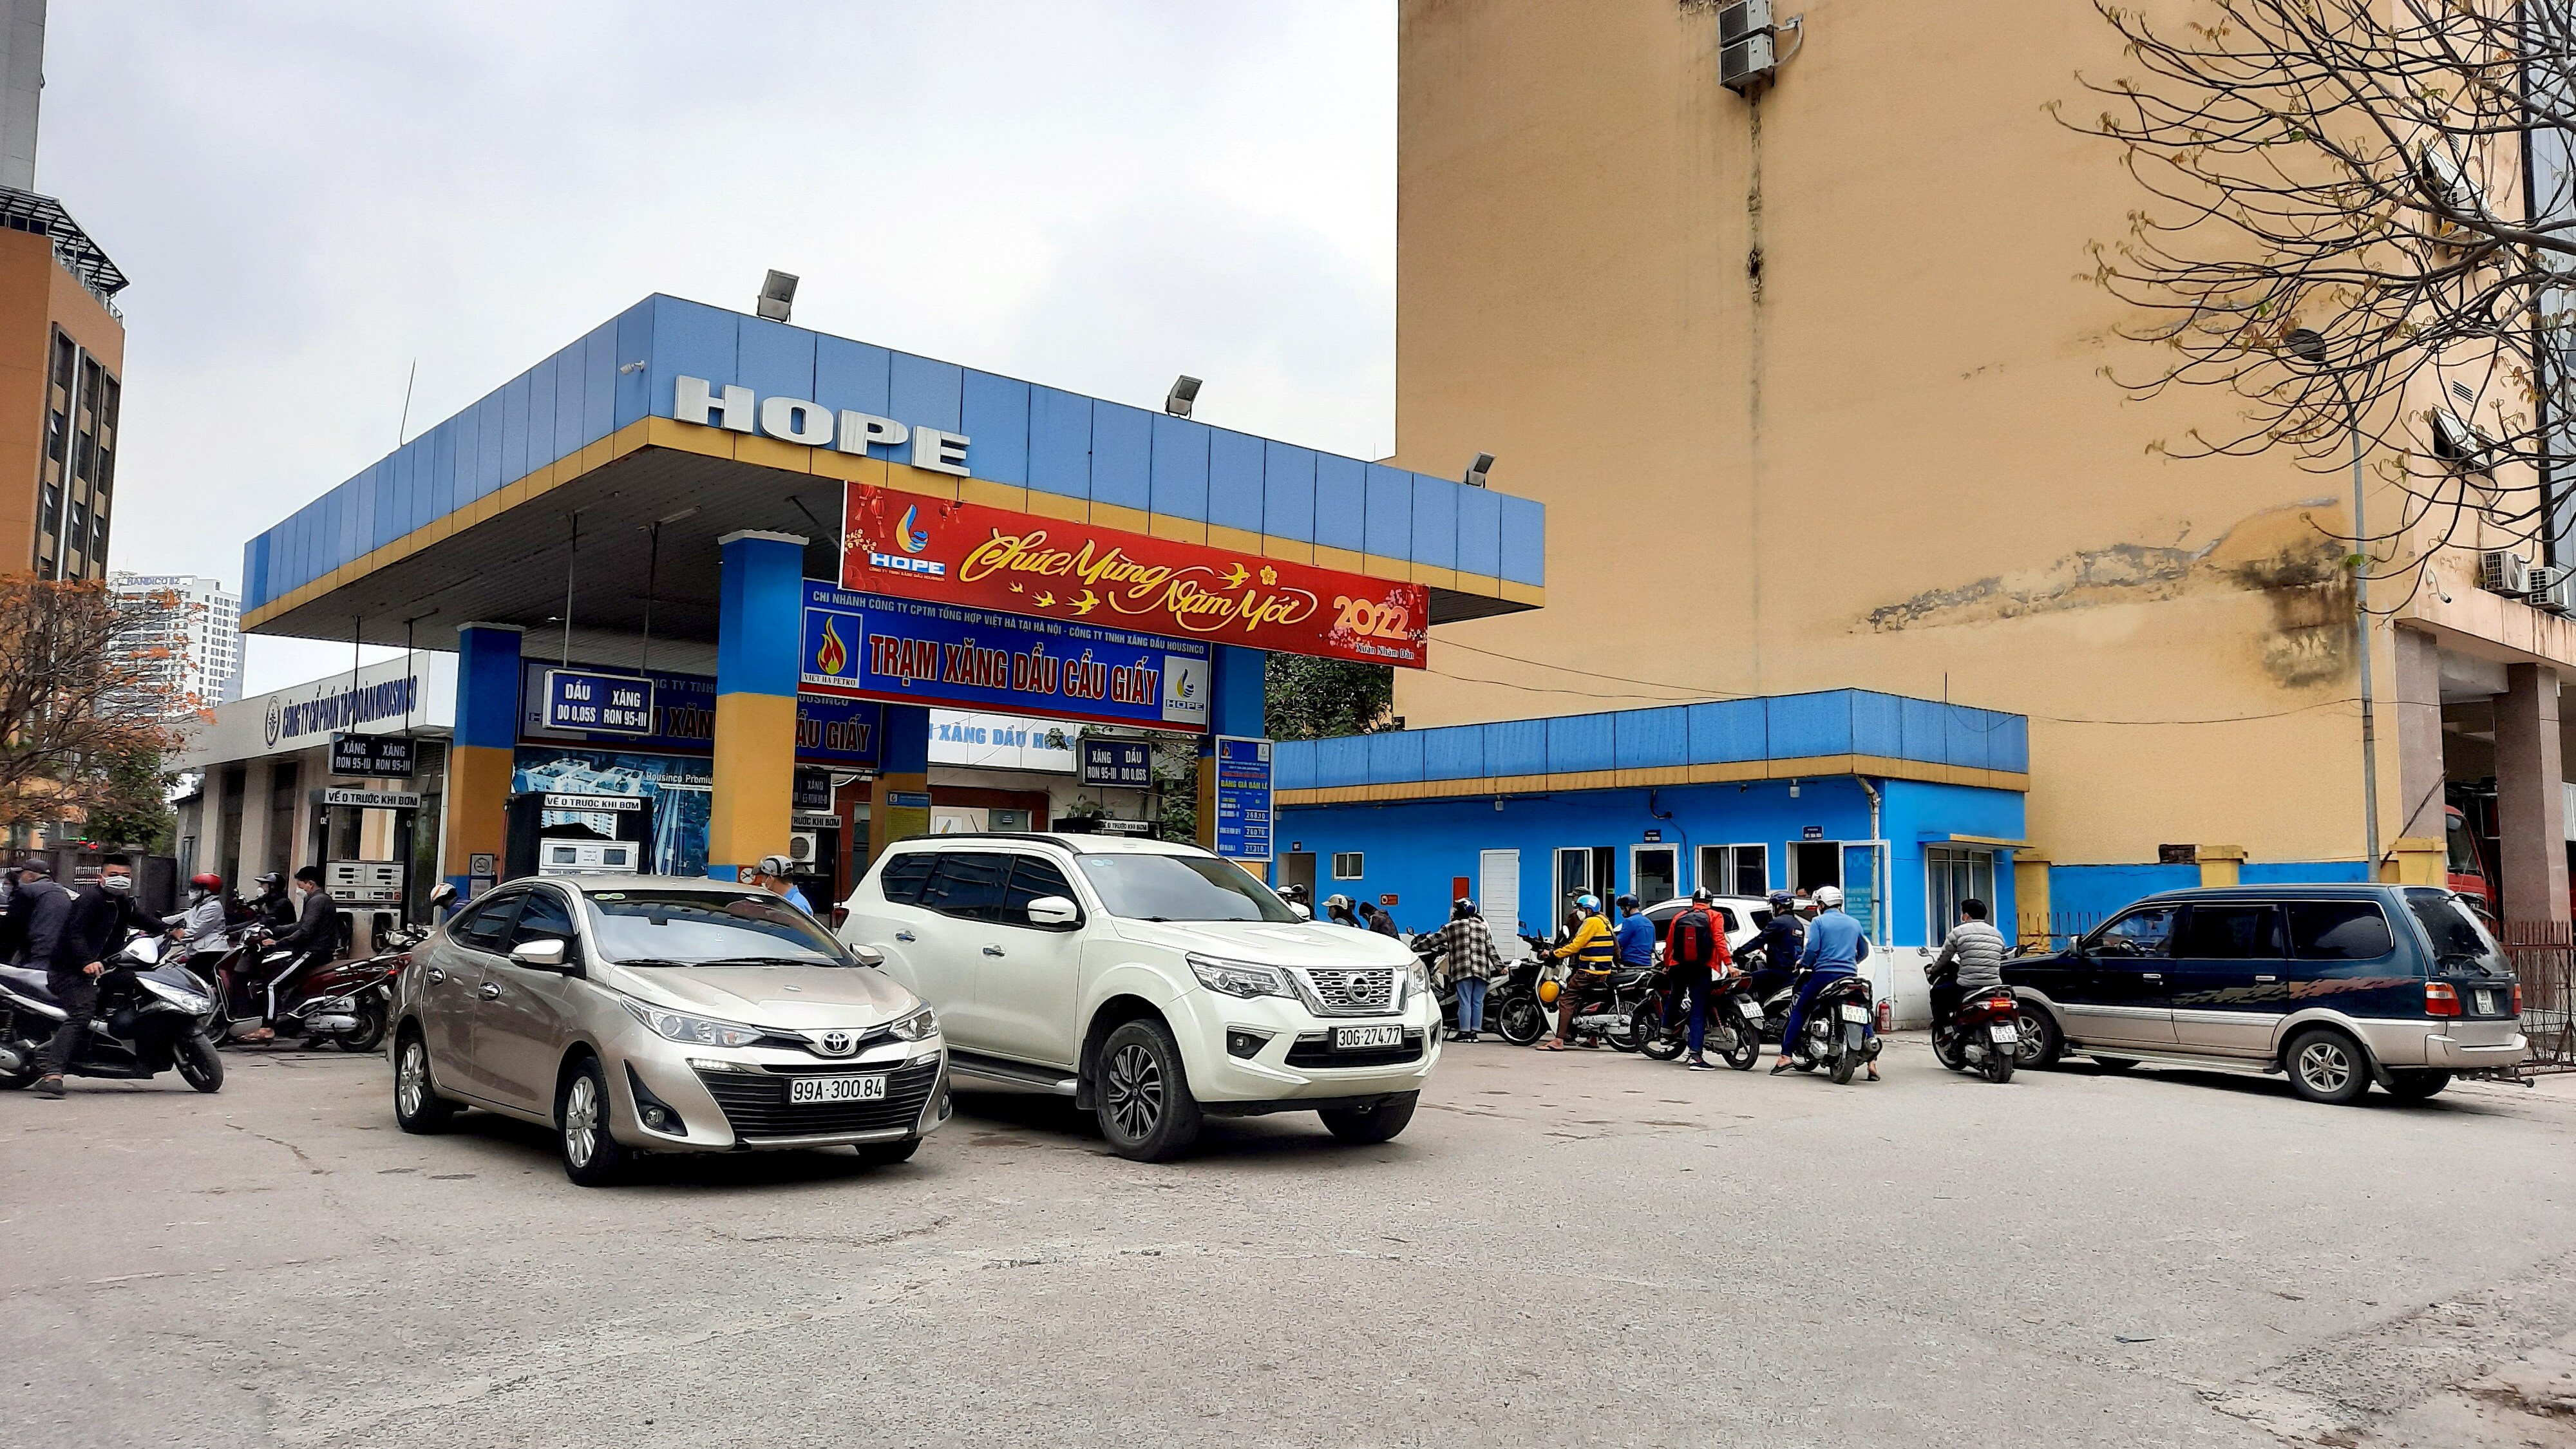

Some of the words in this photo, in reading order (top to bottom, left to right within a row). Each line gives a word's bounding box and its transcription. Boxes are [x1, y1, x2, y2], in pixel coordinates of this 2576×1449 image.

[674, 375, 971, 477] HOPE
[869, 552, 945, 576] HOPE
[960, 527, 1071, 582] Chúc
[1063, 538, 1175, 598] Mừng
[1233, 587, 1318, 632] Mới
[813, 591, 829, 601] CHI
[833, 593, 866, 607] NHÁNH
[869, 598, 895, 611] CÔNG
[897, 603, 907, 613] TY
[910, 604, 936, 618] CPTM
[938, 605, 961, 621] TỔNG
[964, 612, 982, 625] HỢP
[984, 614, 1002, 627] VIỆT
[1005, 616, 1016, 629] HÀ
[1018, 620, 1032, 632] TẠI
[1034, 622, 1045, 633] HÀ
[1047, 623, 1062, 635] NỘI
[1069, 626, 1092, 639] CÔNG
[1094, 630, 1102, 641] TY
[1104, 632, 1125, 644] TNHH
[1127, 630, 1148, 647] XĂNG
[1167, 641, 1204, 654] HOUSINCO
[1334, 596, 1408, 640] 2022
[869, 633, 938, 687] TRẠM
[943, 638, 1009, 689] XĂNG
[1013, 641, 1059, 694] DẦU
[1063, 648, 1108, 700] CẦU
[1111, 656, 1159, 705] GIẤY
[565, 679, 591, 701] DẦU
[672, 679, 686, 690] TY
[377, 675, 417, 721] HOUSINO
[612, 688, 641, 707] XĂNG
[1165, 699, 1204, 711] HOPE
[557, 704, 569, 720] DO
[571, 706, 596, 723] 0,05S
[603, 708, 622, 724] RON
[624, 710, 647, 726] 95-III
[667, 702, 715, 740] XĂN
[796, 708, 822, 748] ẦU
[826, 714, 871, 752] GIẤY
[938, 721, 987, 744] XĂNG
[992, 724, 1027, 748] DẦU
[343, 740, 366, 755] XĂNG
[383, 743, 406, 757] XĂNG
[1092, 748, 1112, 764] XĂNG
[1125, 746, 1142, 764] DẦU
[336, 756, 351, 768] RON
[375, 759, 390, 770] RON
[645, 772, 683, 784] Housinco
[685, 774, 713, 785] Premiu
[1087, 766, 1100, 779] RON
[1121, 767, 1130, 779] DO
[328, 790, 340, 802] VỀ
[350, 793, 379, 804] TRƯỚC
[381, 795, 396, 805] KHI
[601, 800, 617, 809] KHI
[793, 815, 811, 825] RƯỚC
[813, 817, 824, 826] KHI
[1338, 1027, 1401, 1046] 30G-274.77
[793, 1078, 883, 1101] 99A-300.84
